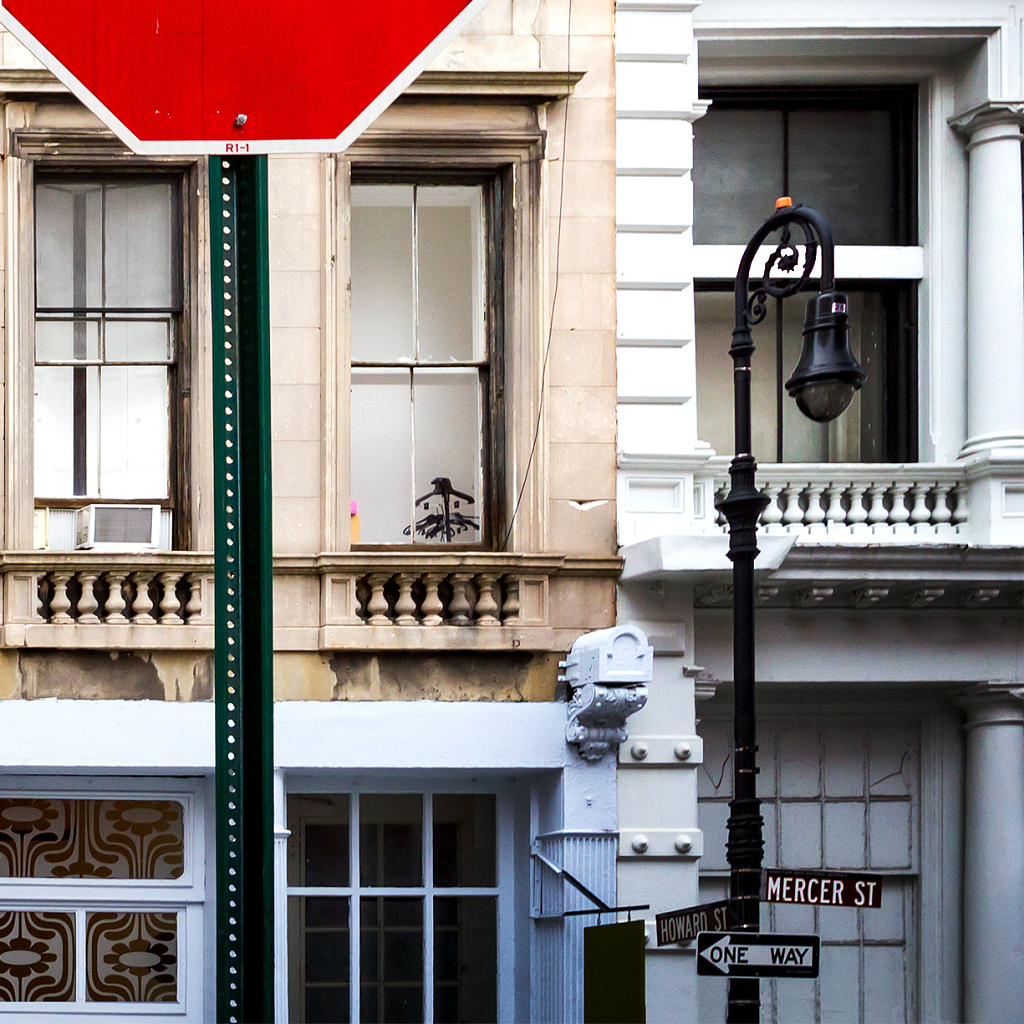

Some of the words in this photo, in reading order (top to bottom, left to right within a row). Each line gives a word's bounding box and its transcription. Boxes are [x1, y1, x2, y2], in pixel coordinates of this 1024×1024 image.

[226, 143, 250, 153] R1-1
[767, 876, 843, 904] MERCER
[854, 881, 877, 906] ST
[660, 911, 707, 942] HOWARD
[713, 906, 727, 931] ST
[710, 946, 749, 963] ONE
[770, 947, 809, 965] WAY
